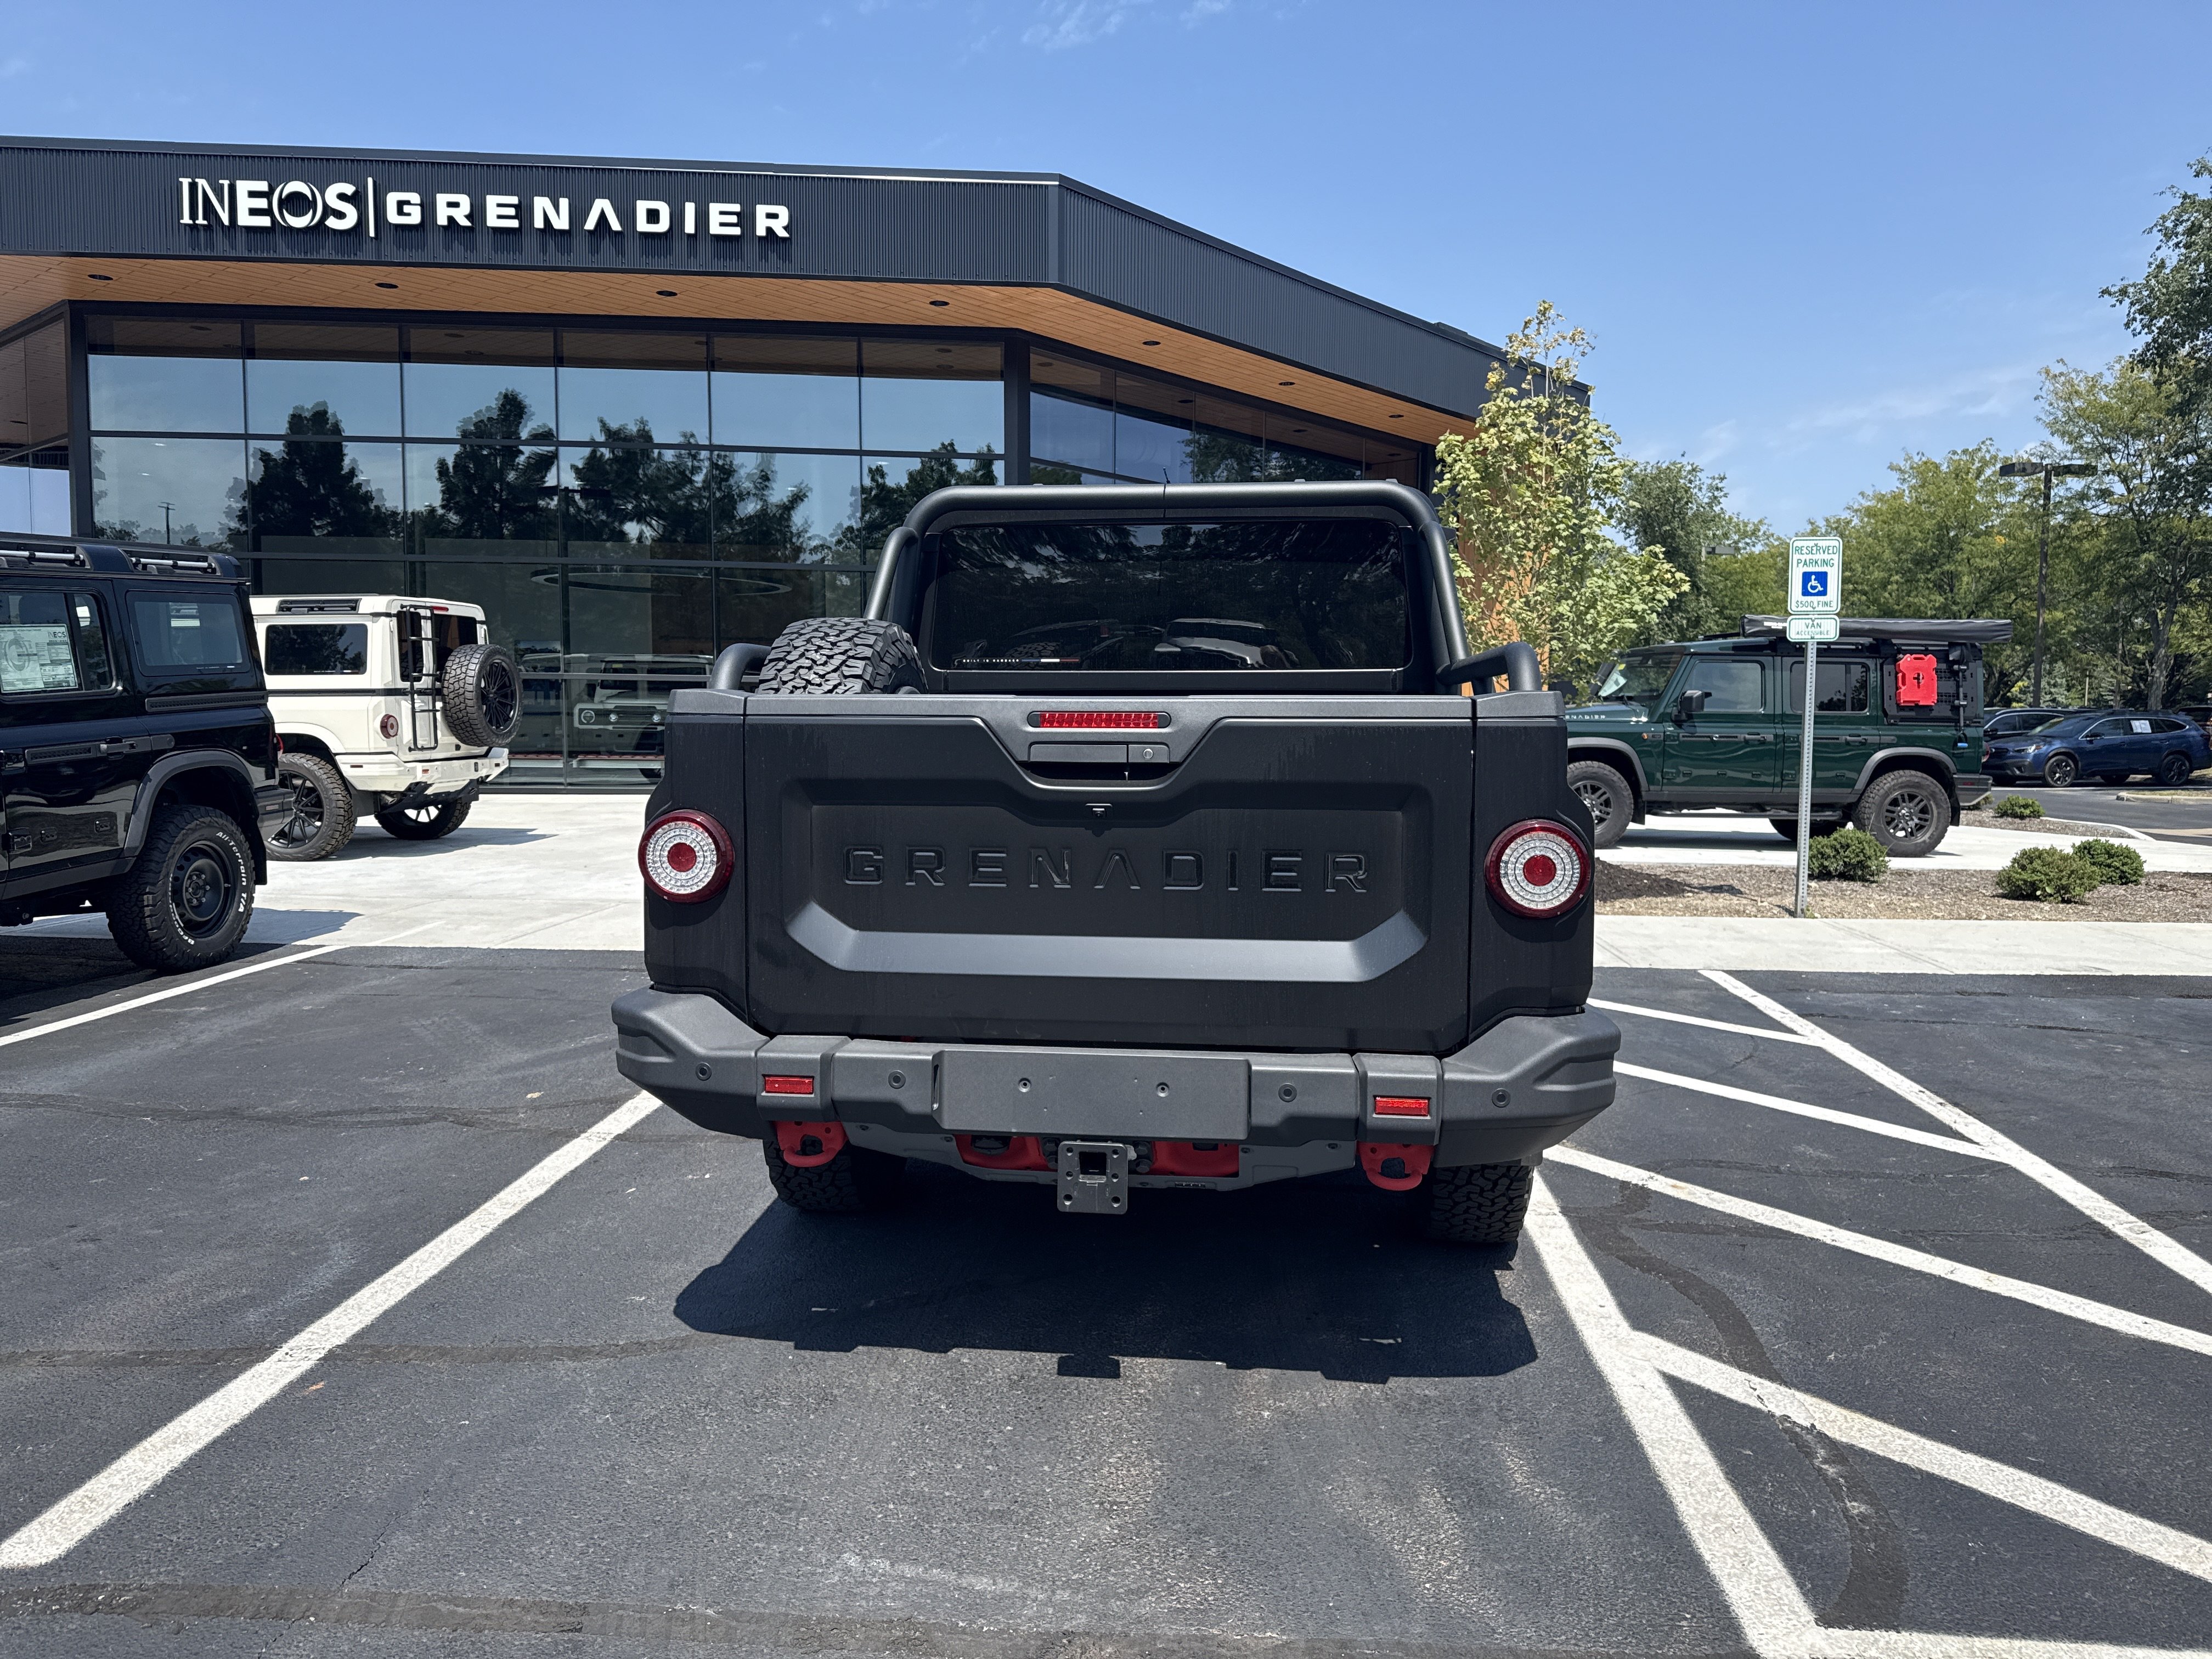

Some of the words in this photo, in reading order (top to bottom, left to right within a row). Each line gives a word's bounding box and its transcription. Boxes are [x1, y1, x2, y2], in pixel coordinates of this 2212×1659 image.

[179, 177, 358, 230] INEOS
[386, 191, 790, 238] GRENADIER
[1795, 545, 1838, 555] RESERVED
[1797, 558, 1835, 568] PARKING
[1795, 600, 1814, 608] $500
[216, 832, 247, 885] All-Terrain
[238, 893, 247, 912] T/A
[843, 844, 1367, 893] GRENADIER
